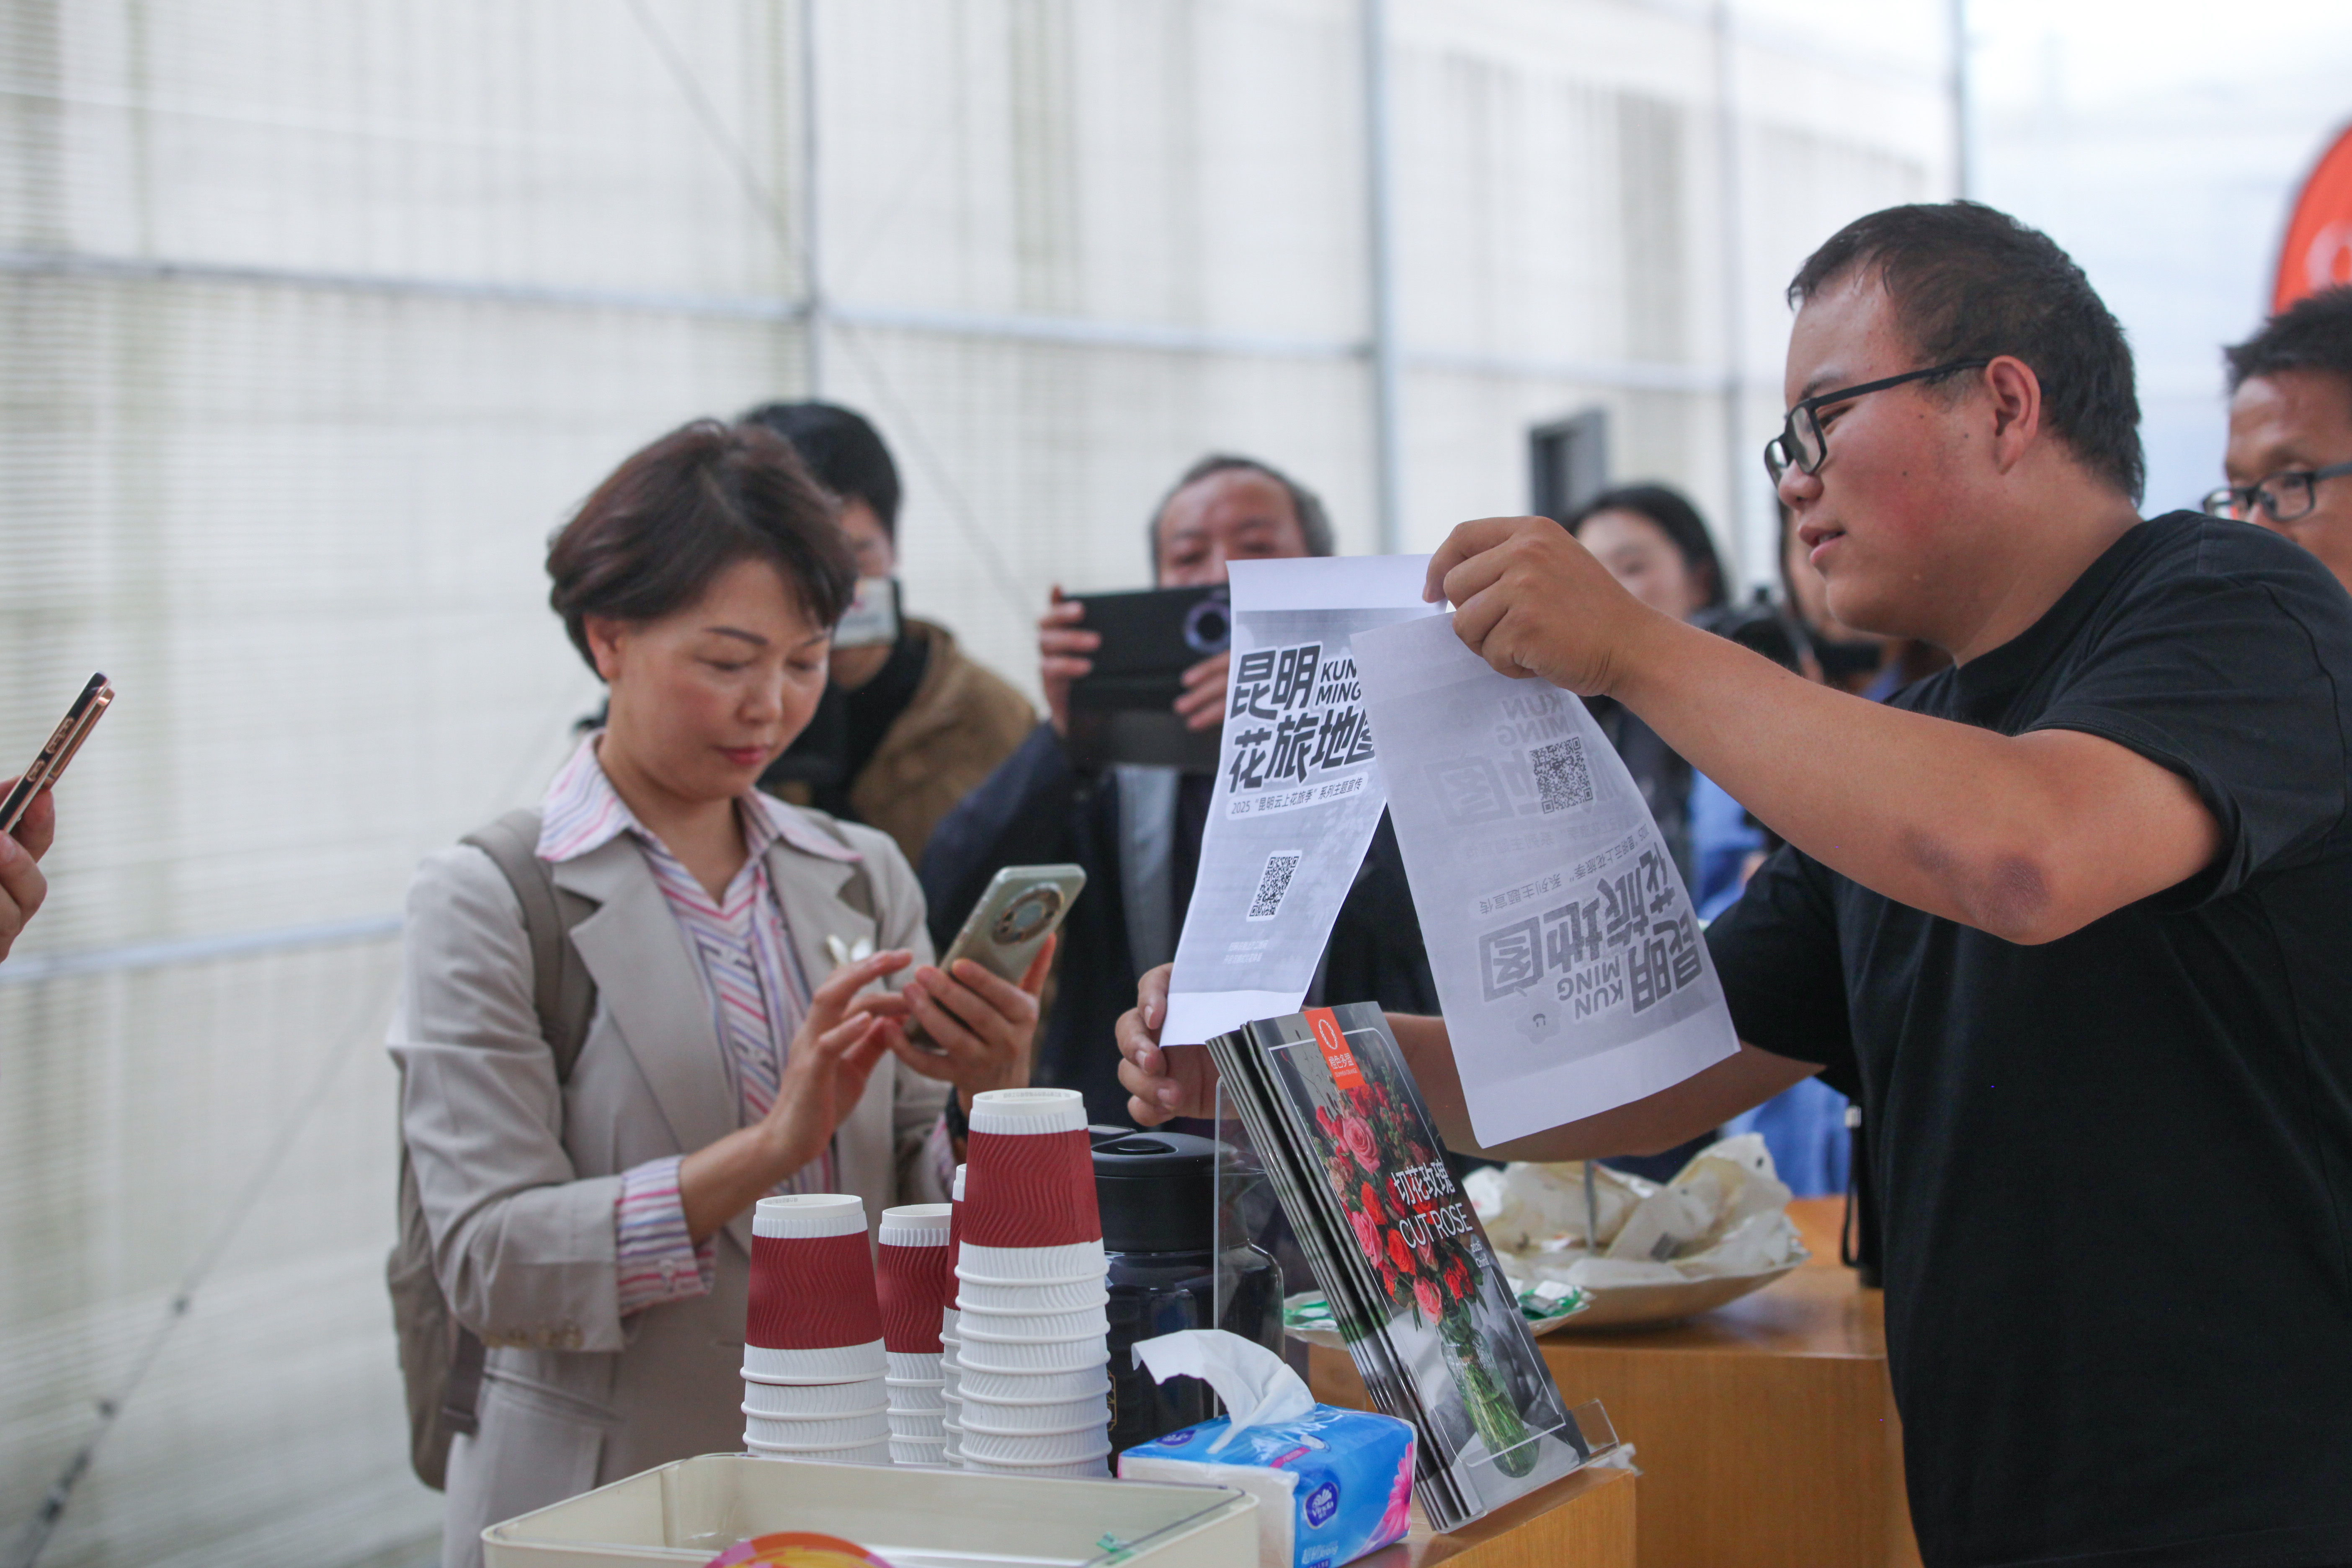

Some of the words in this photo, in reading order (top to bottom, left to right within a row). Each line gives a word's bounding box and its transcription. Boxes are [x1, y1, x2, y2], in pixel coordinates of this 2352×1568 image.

[1230, 645, 1320, 720] 昆明
[1320, 658, 1357, 682] KUN
[1315, 681, 1361, 706] MING
[1479, 842, 1675, 1002] 花旅地图
[1557, 956, 1620, 1001] MING
[1628, 909, 1702, 1014] 昆明
[1575, 979, 1624, 1019] KUN
[1391, 1159, 1455, 1206] 切花玫瑰
[1399, 1213, 1434, 1248] CUT
[1429, 1202, 1473, 1239] ROSE
